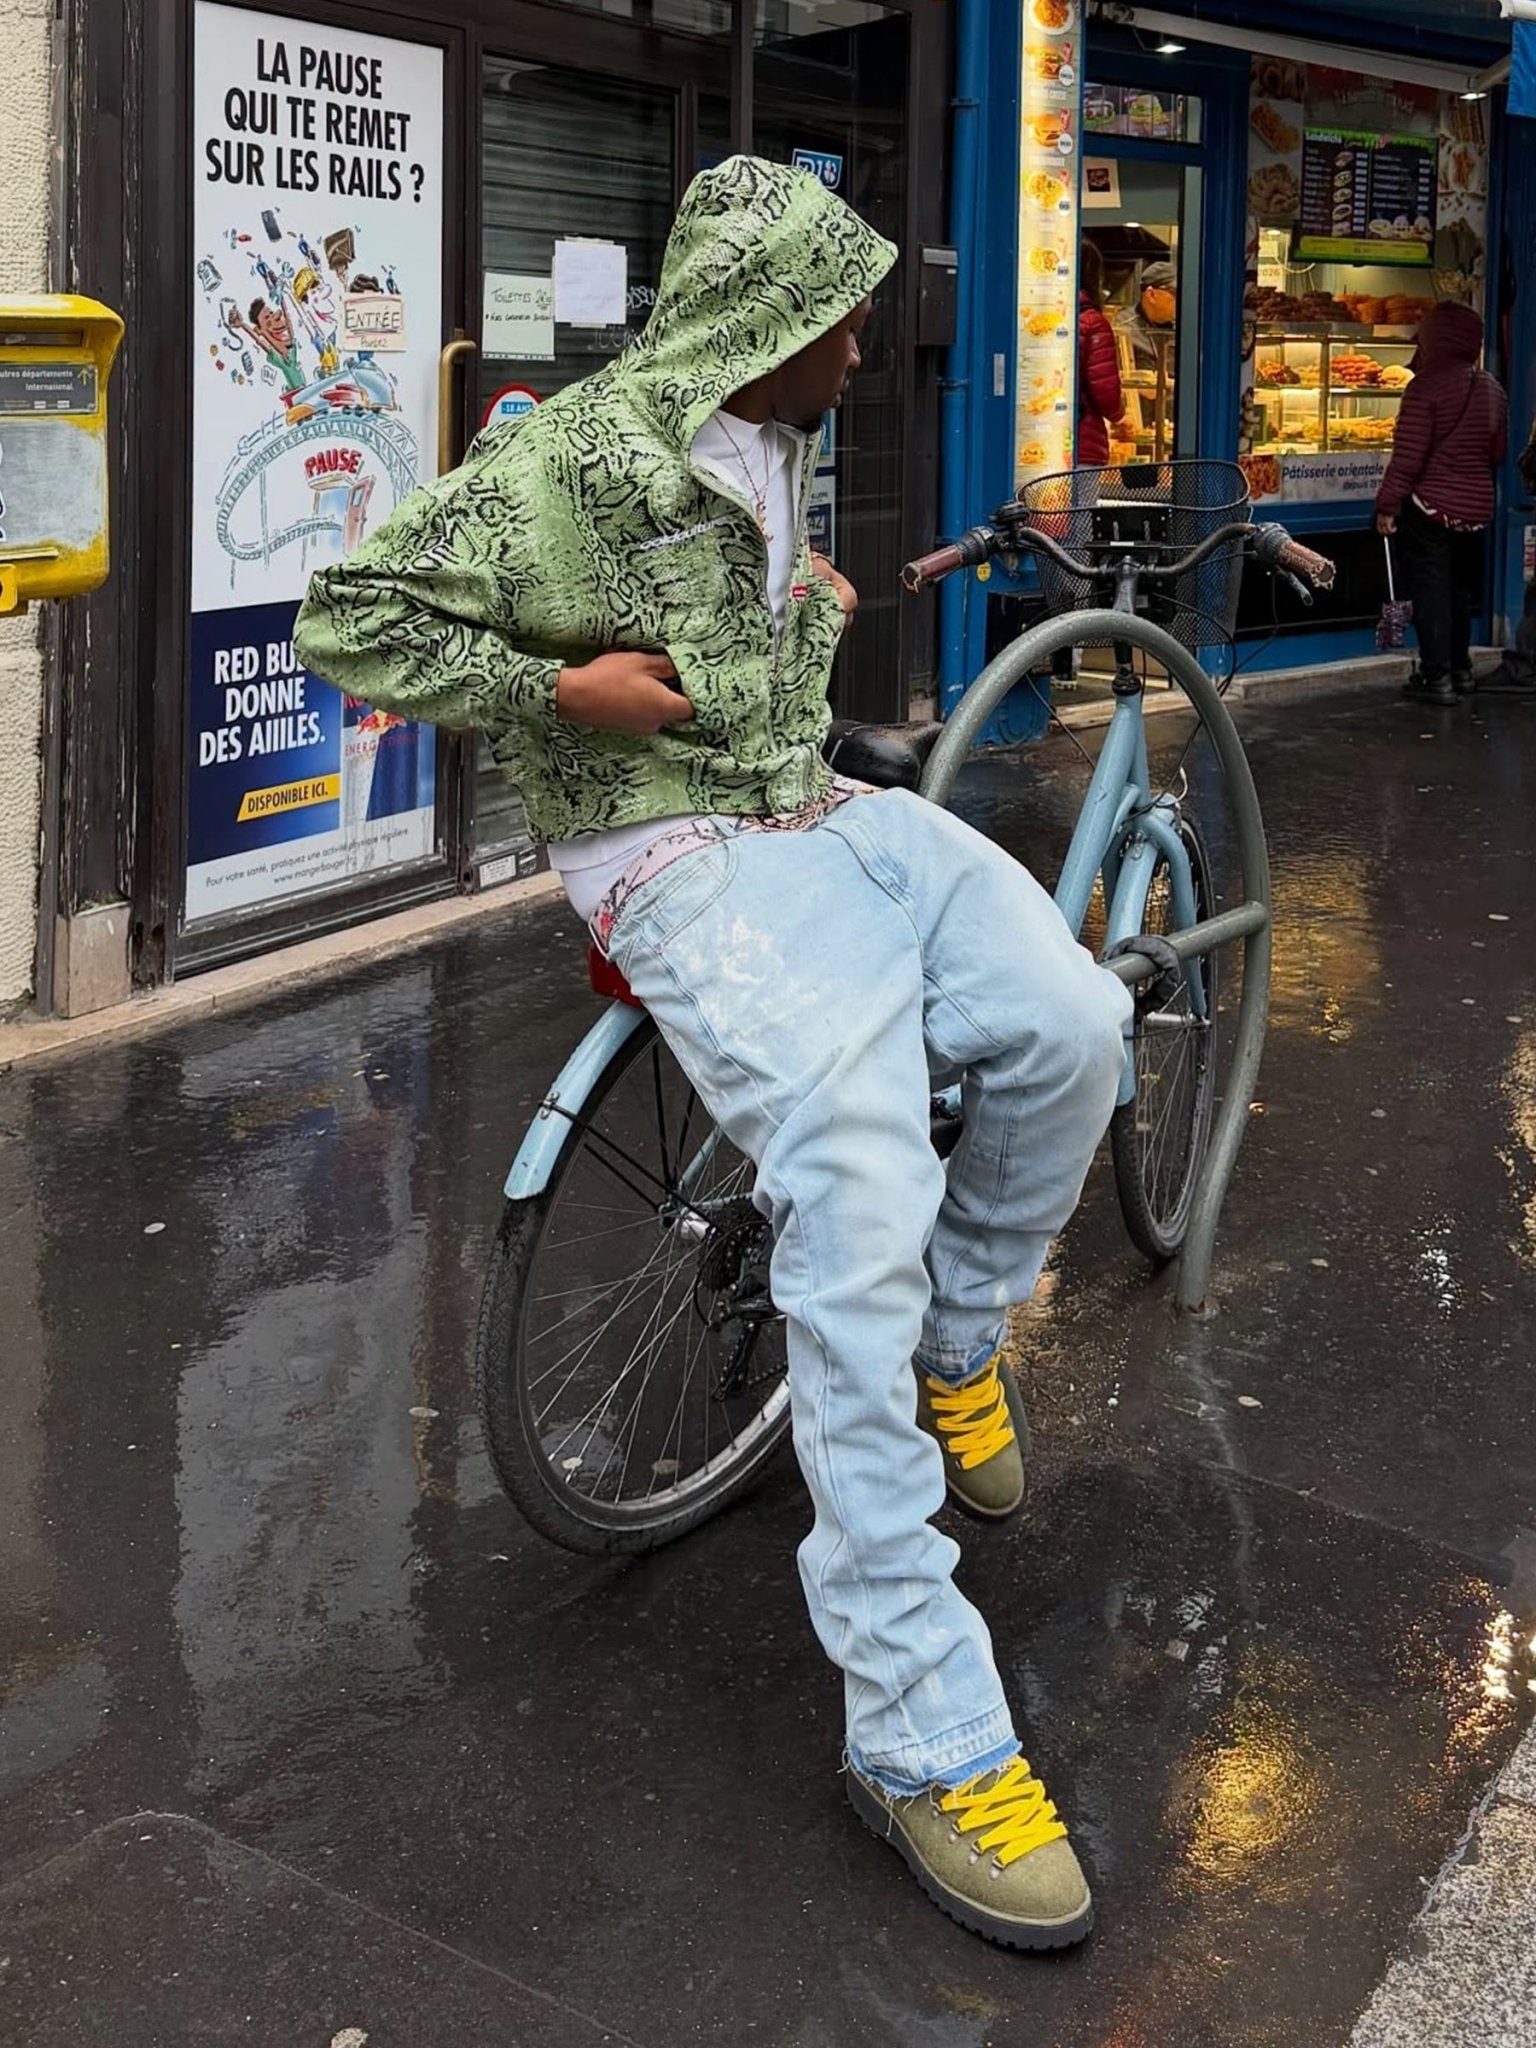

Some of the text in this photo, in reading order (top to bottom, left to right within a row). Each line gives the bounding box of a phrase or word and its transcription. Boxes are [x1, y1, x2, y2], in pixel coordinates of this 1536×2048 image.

[257, 38, 382, 99] LA PAUSE
[224, 87, 411, 152] QUI TE REMET
[206, 138, 425, 203] SUR LES RAILS ?
[345, 305, 400, 329] ENTRÉE
[0, 369, 73, 379] utres départements
[25, 383, 74, 392] International
[304, 448, 362, 478] PAUSE
[1282, 463, 1384, 480] Pâtisserie orientale
[214, 645, 260, 685] RED
[225, 676, 305, 722] DONNE
[199, 726, 242, 767] DES
[344, 738, 386, 757] ENERG
[247, 781, 328, 813] DISPONIBLE ICI.
